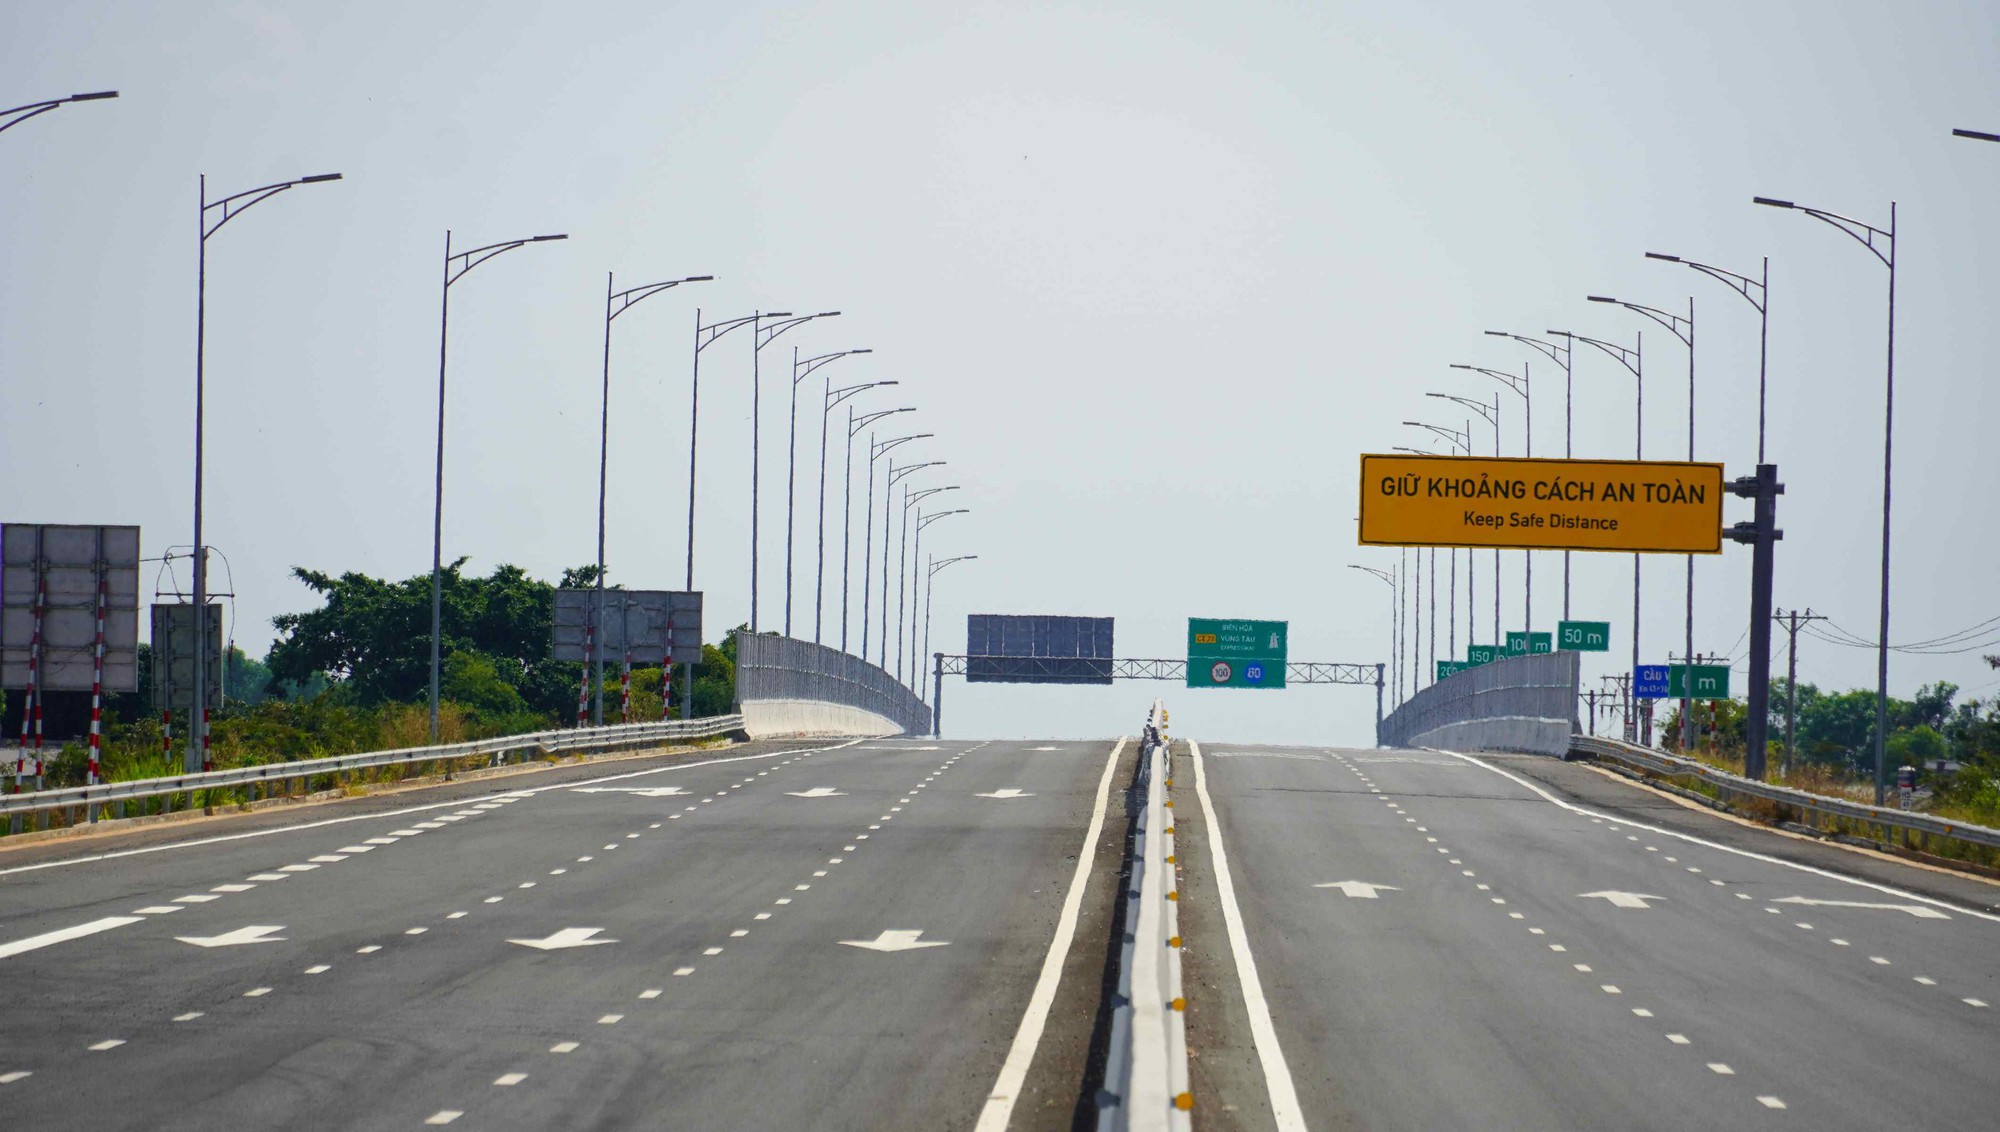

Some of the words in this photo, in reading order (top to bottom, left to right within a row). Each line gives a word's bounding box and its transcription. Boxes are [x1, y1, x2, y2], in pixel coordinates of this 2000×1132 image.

[1381, 473, 1421, 497] GIỮ
[1428, 473, 1526, 499] KHOẢNG
[1534, 476, 1594, 502] CÁCH
[1602, 482, 1635, 502] AN
[1643, 478, 1706, 505] TOÀN
[1464, 511, 1504, 529] Keep
[1509, 512, 1544, 528] Safe
[1550, 514, 1618, 530] Distance
[1565, 629, 1582, 643] 50
[1587, 633, 1602, 644] m
[1535, 642, 1548, 651] m
[1471, 651, 1490, 662] 150
[1215, 667, 1228, 677] 100
[1698, 678, 1716, 690] m
